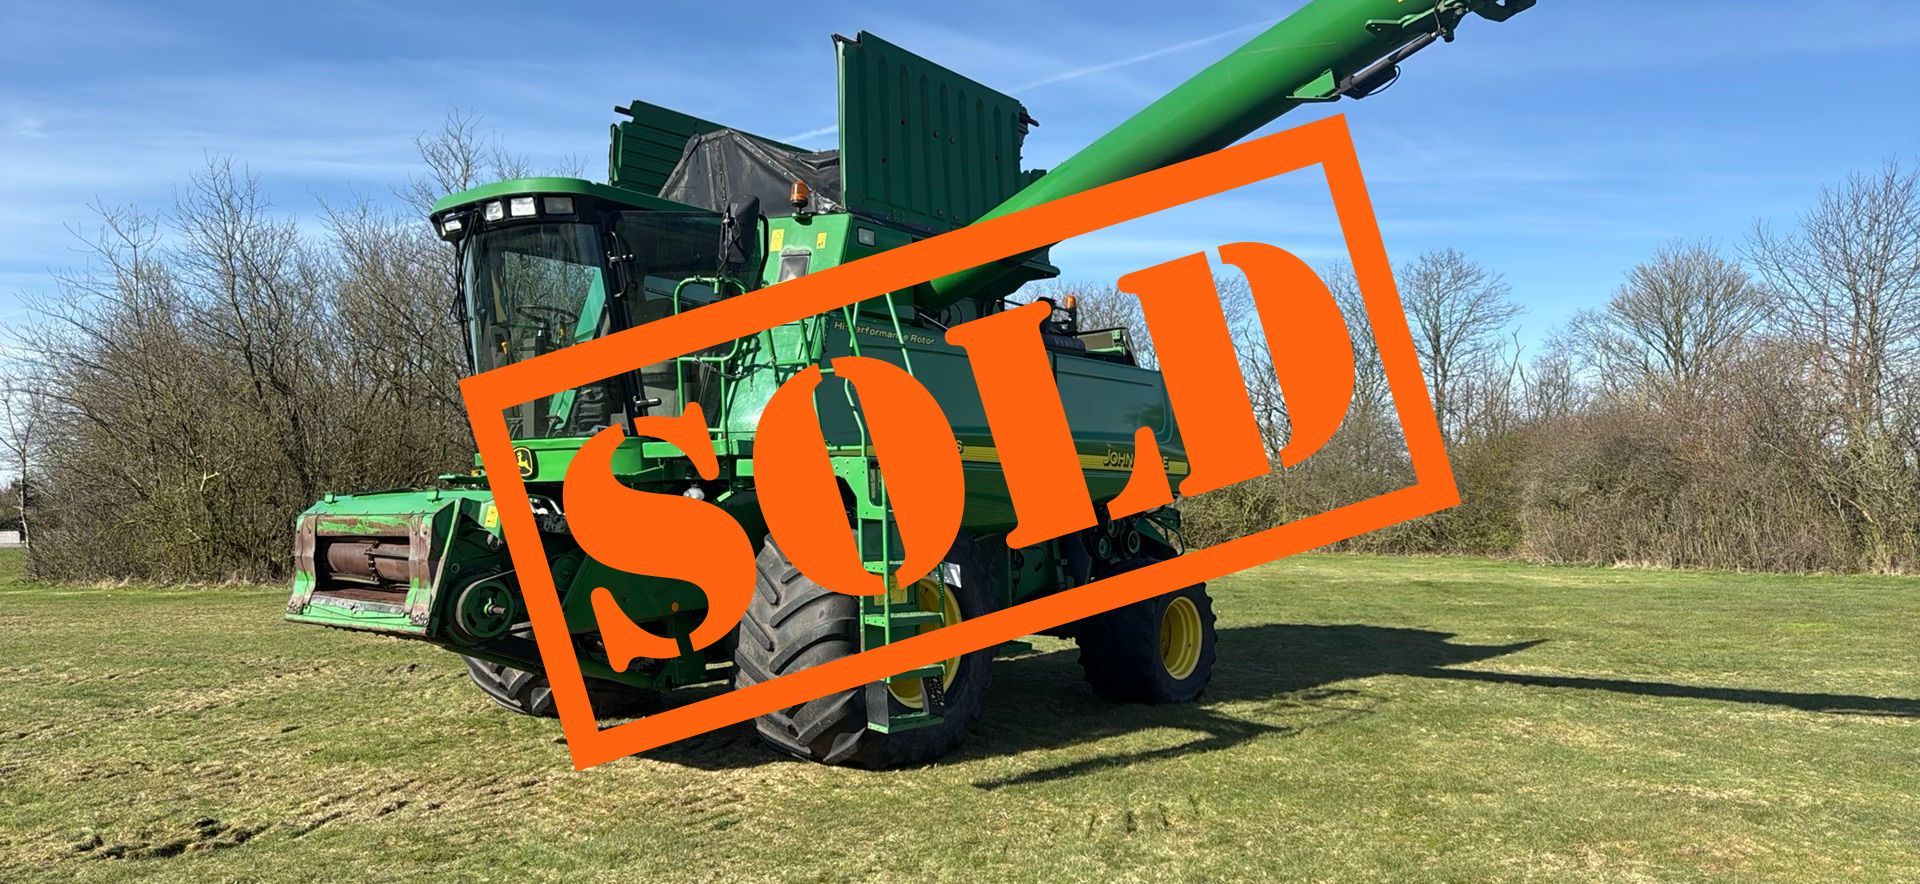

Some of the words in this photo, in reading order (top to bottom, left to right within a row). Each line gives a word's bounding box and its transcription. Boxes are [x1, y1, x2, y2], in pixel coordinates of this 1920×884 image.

[834, 321, 908, 340] Hi-erformane
[910, 333, 935, 345] Rotor
[1103, 448, 1134, 465] JOHN
